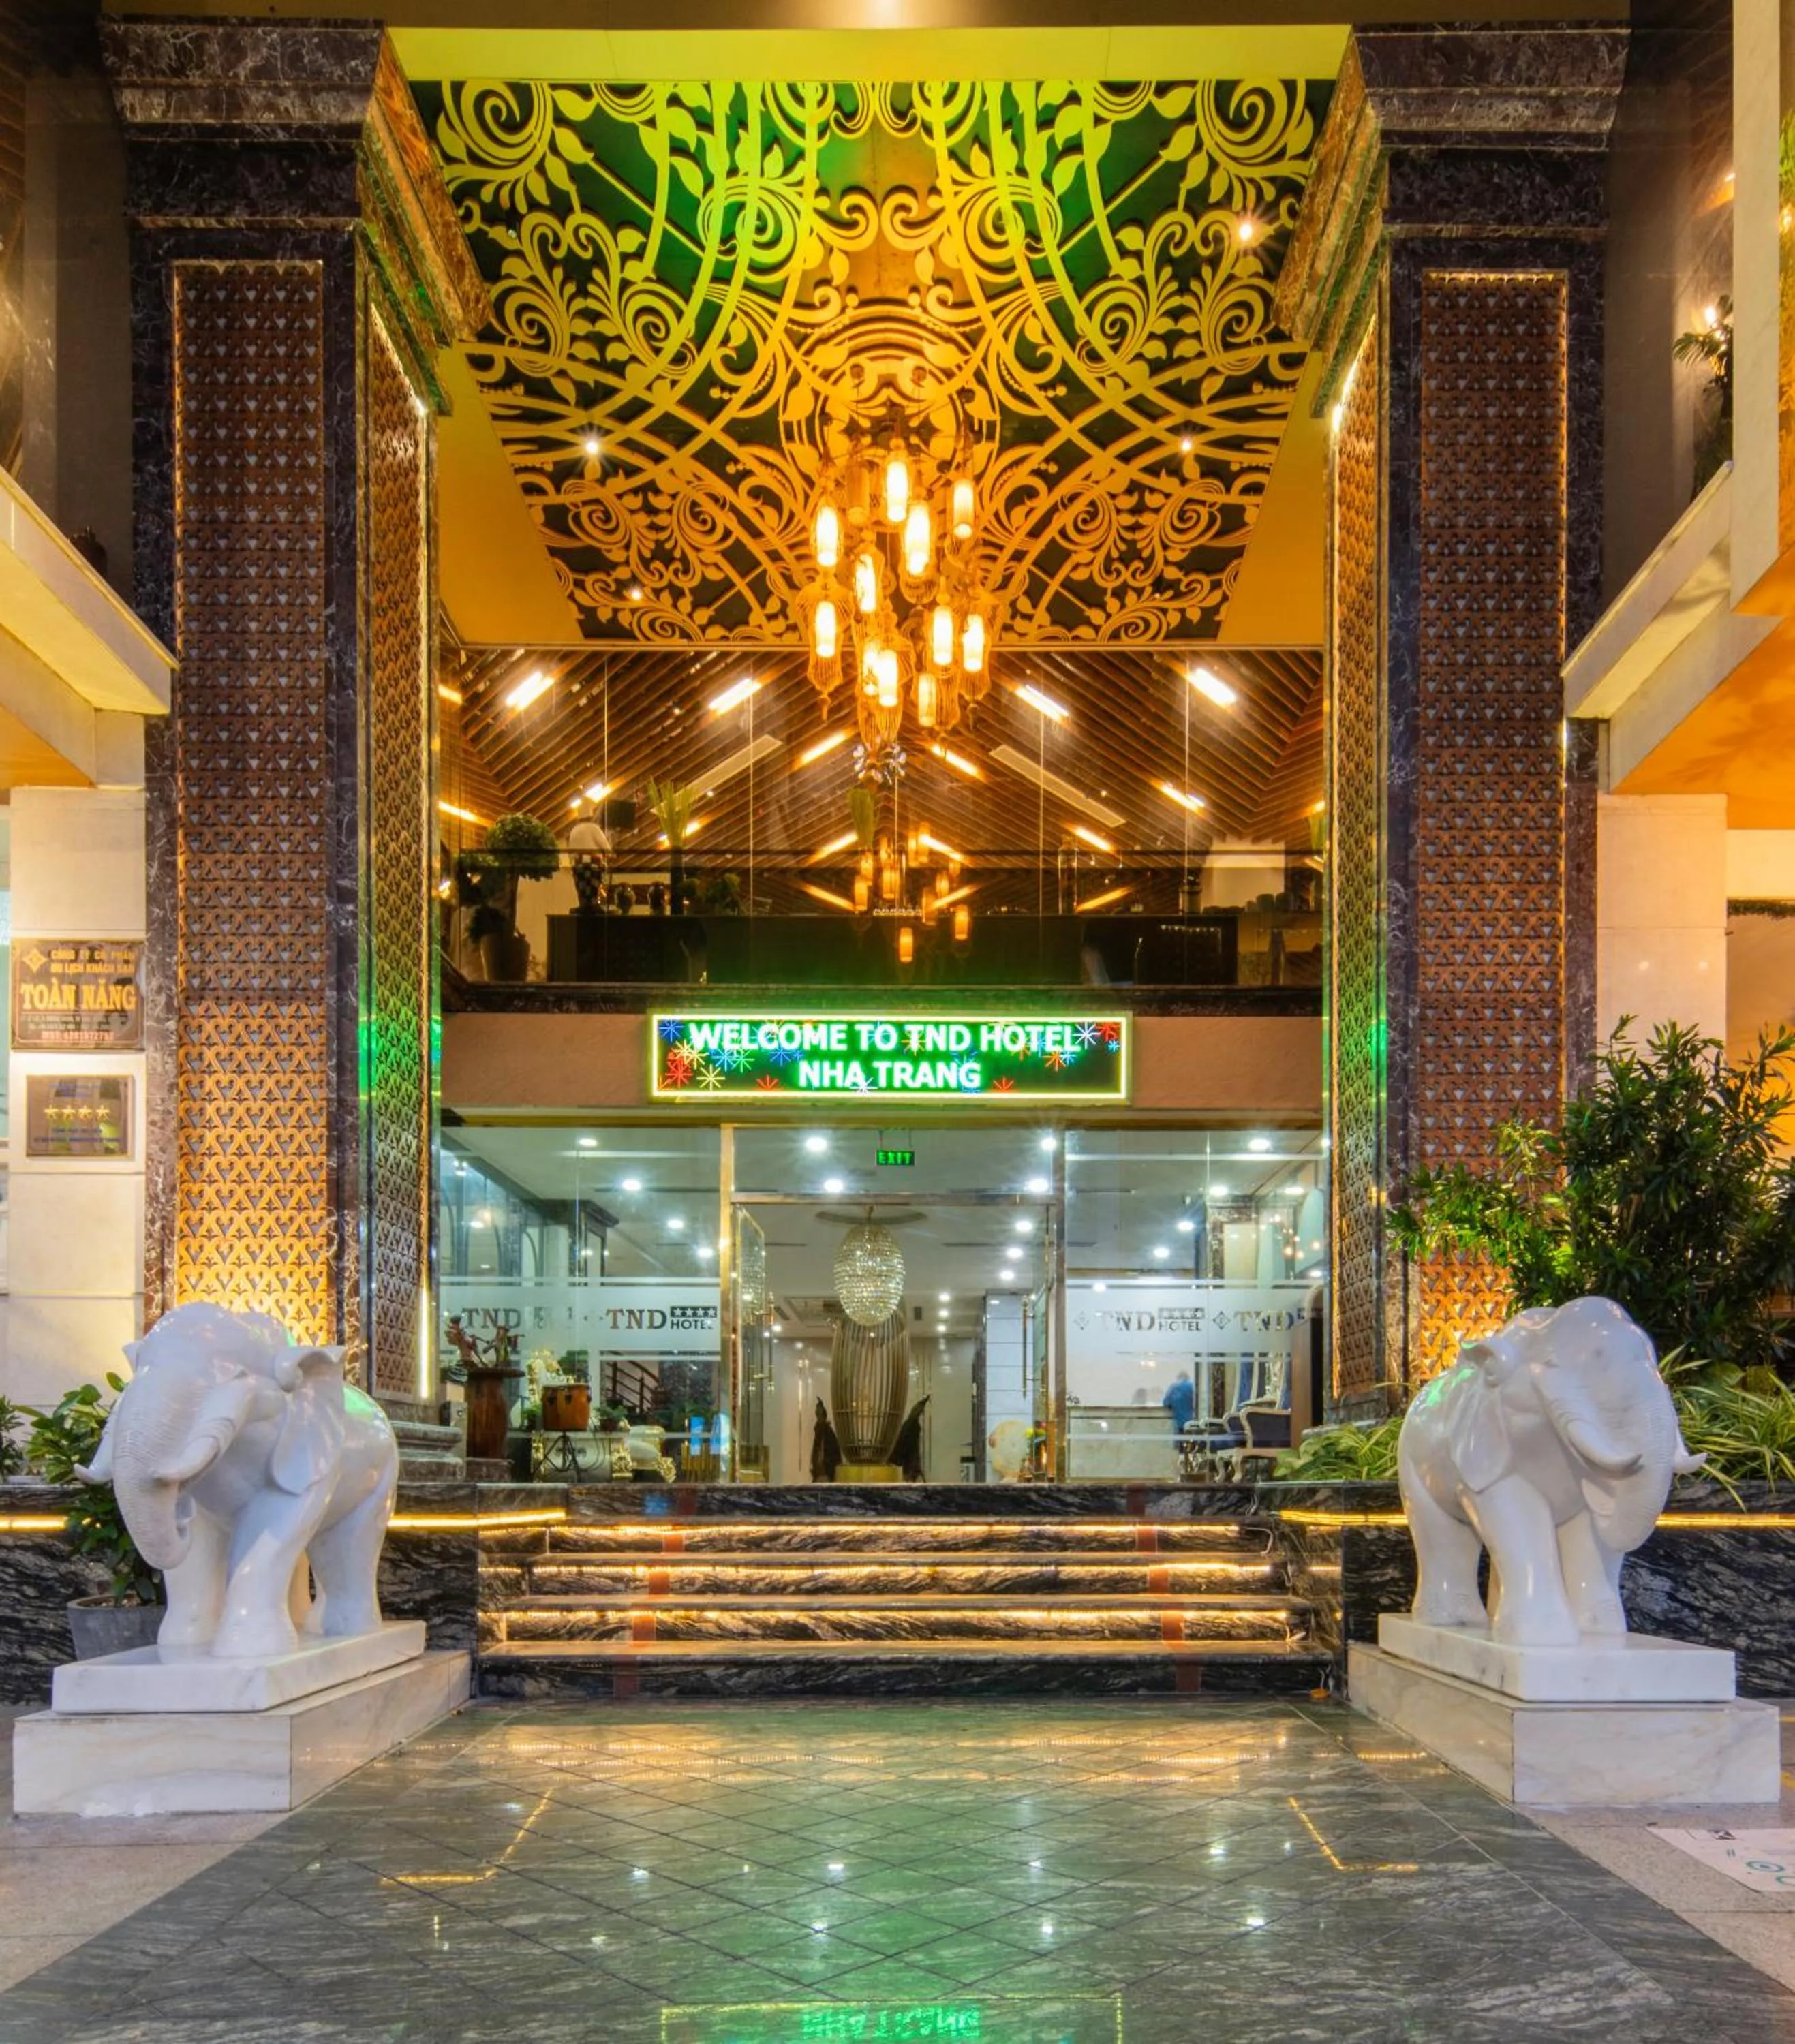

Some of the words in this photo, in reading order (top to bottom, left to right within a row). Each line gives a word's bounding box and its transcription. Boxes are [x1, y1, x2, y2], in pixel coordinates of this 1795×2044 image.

[20, 977, 77, 1010] TOÀN
[81, 978, 137, 1010] NĂNG
[688, 1023, 847, 1051] WELCOME
[855, 1024, 898, 1051] TO
[904, 1024, 971, 1051] TND
[981, 1025, 1081, 1052] HOTEL
[799, 1061, 865, 1088] NHA
[873, 1062, 981, 1088] TRANG
[878, 1152, 911, 1164] EXIT
[463, 1307, 521, 1329] TND
[606, 1308, 667, 1329] TND
